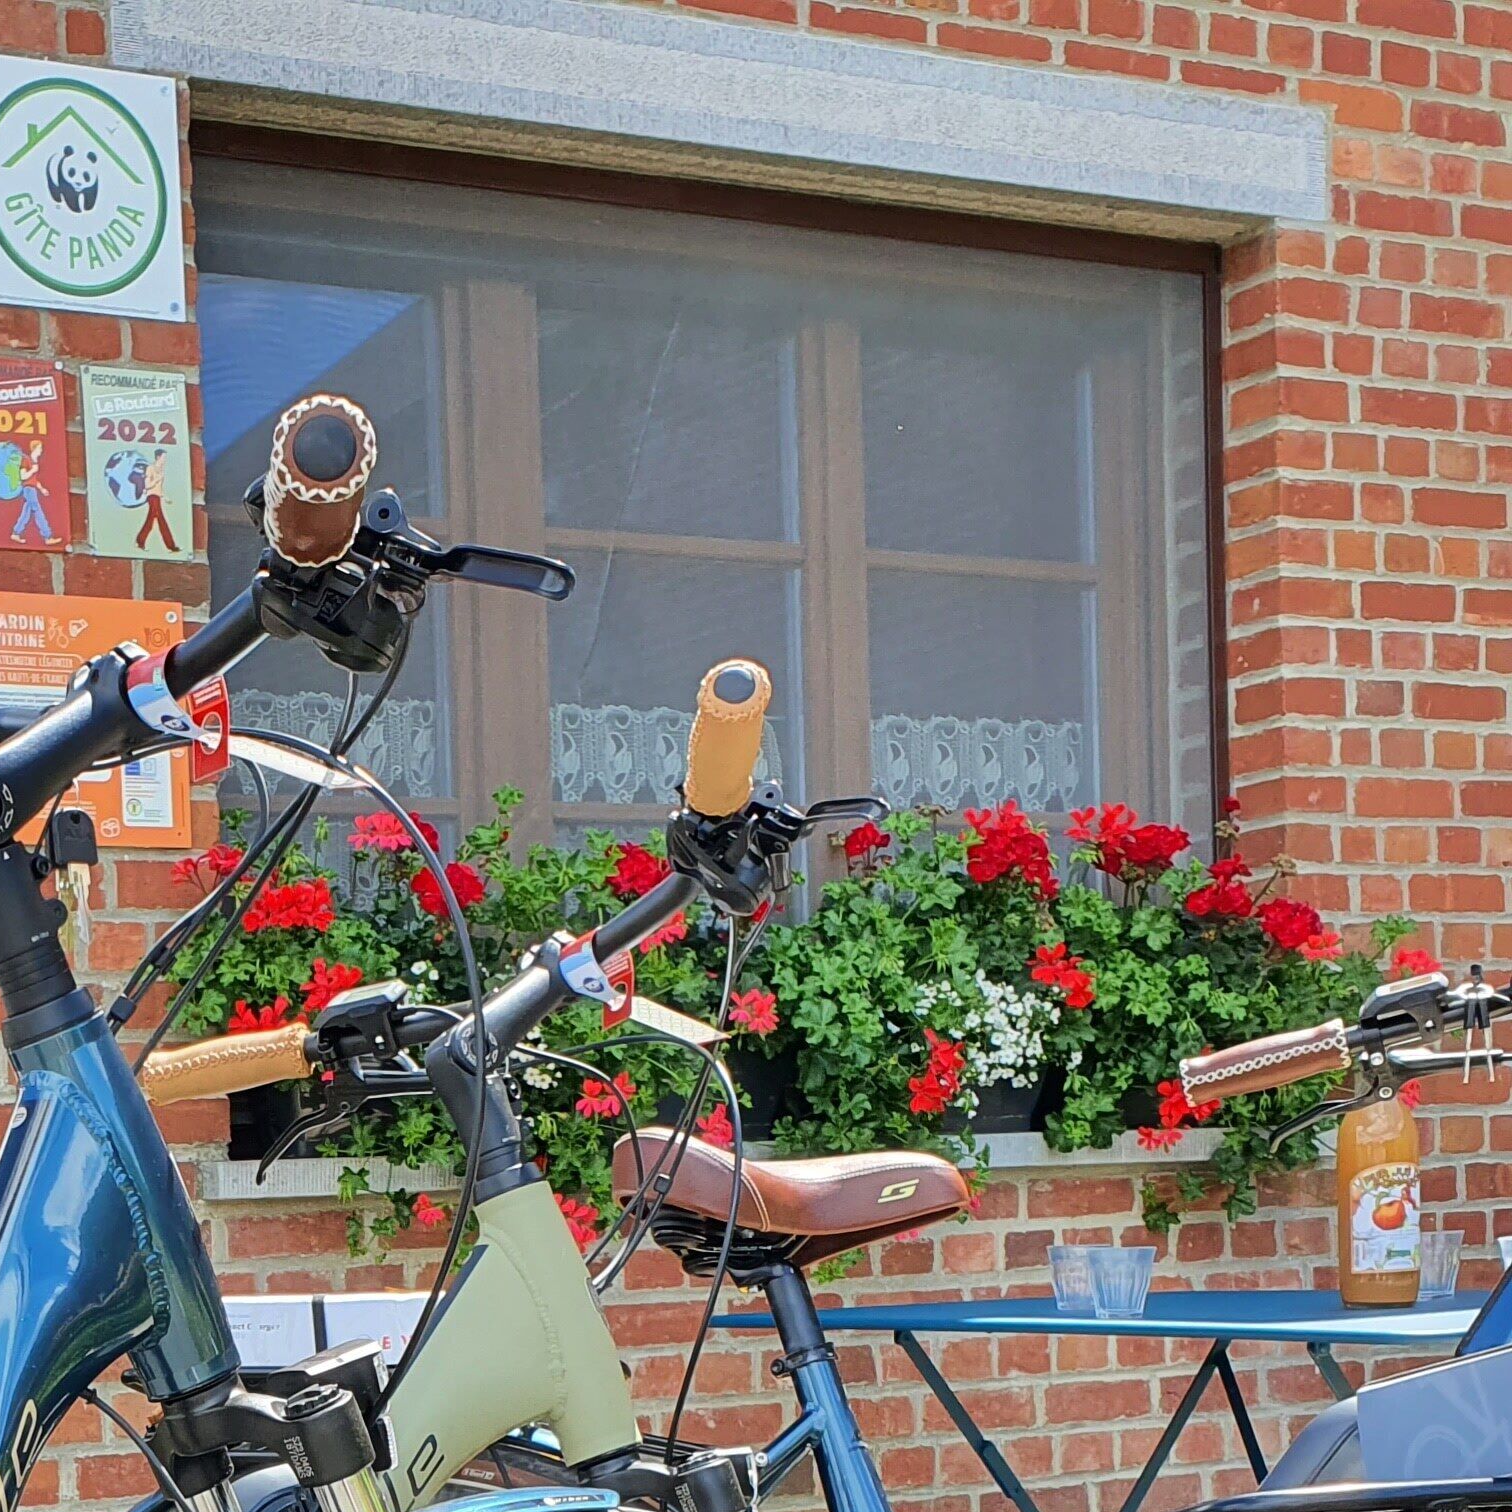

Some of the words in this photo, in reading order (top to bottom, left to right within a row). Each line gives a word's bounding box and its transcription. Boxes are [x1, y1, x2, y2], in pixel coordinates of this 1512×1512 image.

[4, 192, 61, 261] GÎTE
[69, 205, 145, 270] PANDA
[90, 373, 157, 390] RECOMMANDÉ
[95, 400, 113, 415] Le
[113, 392, 176, 412] Routard
[97, 418, 177, 446] 2022
